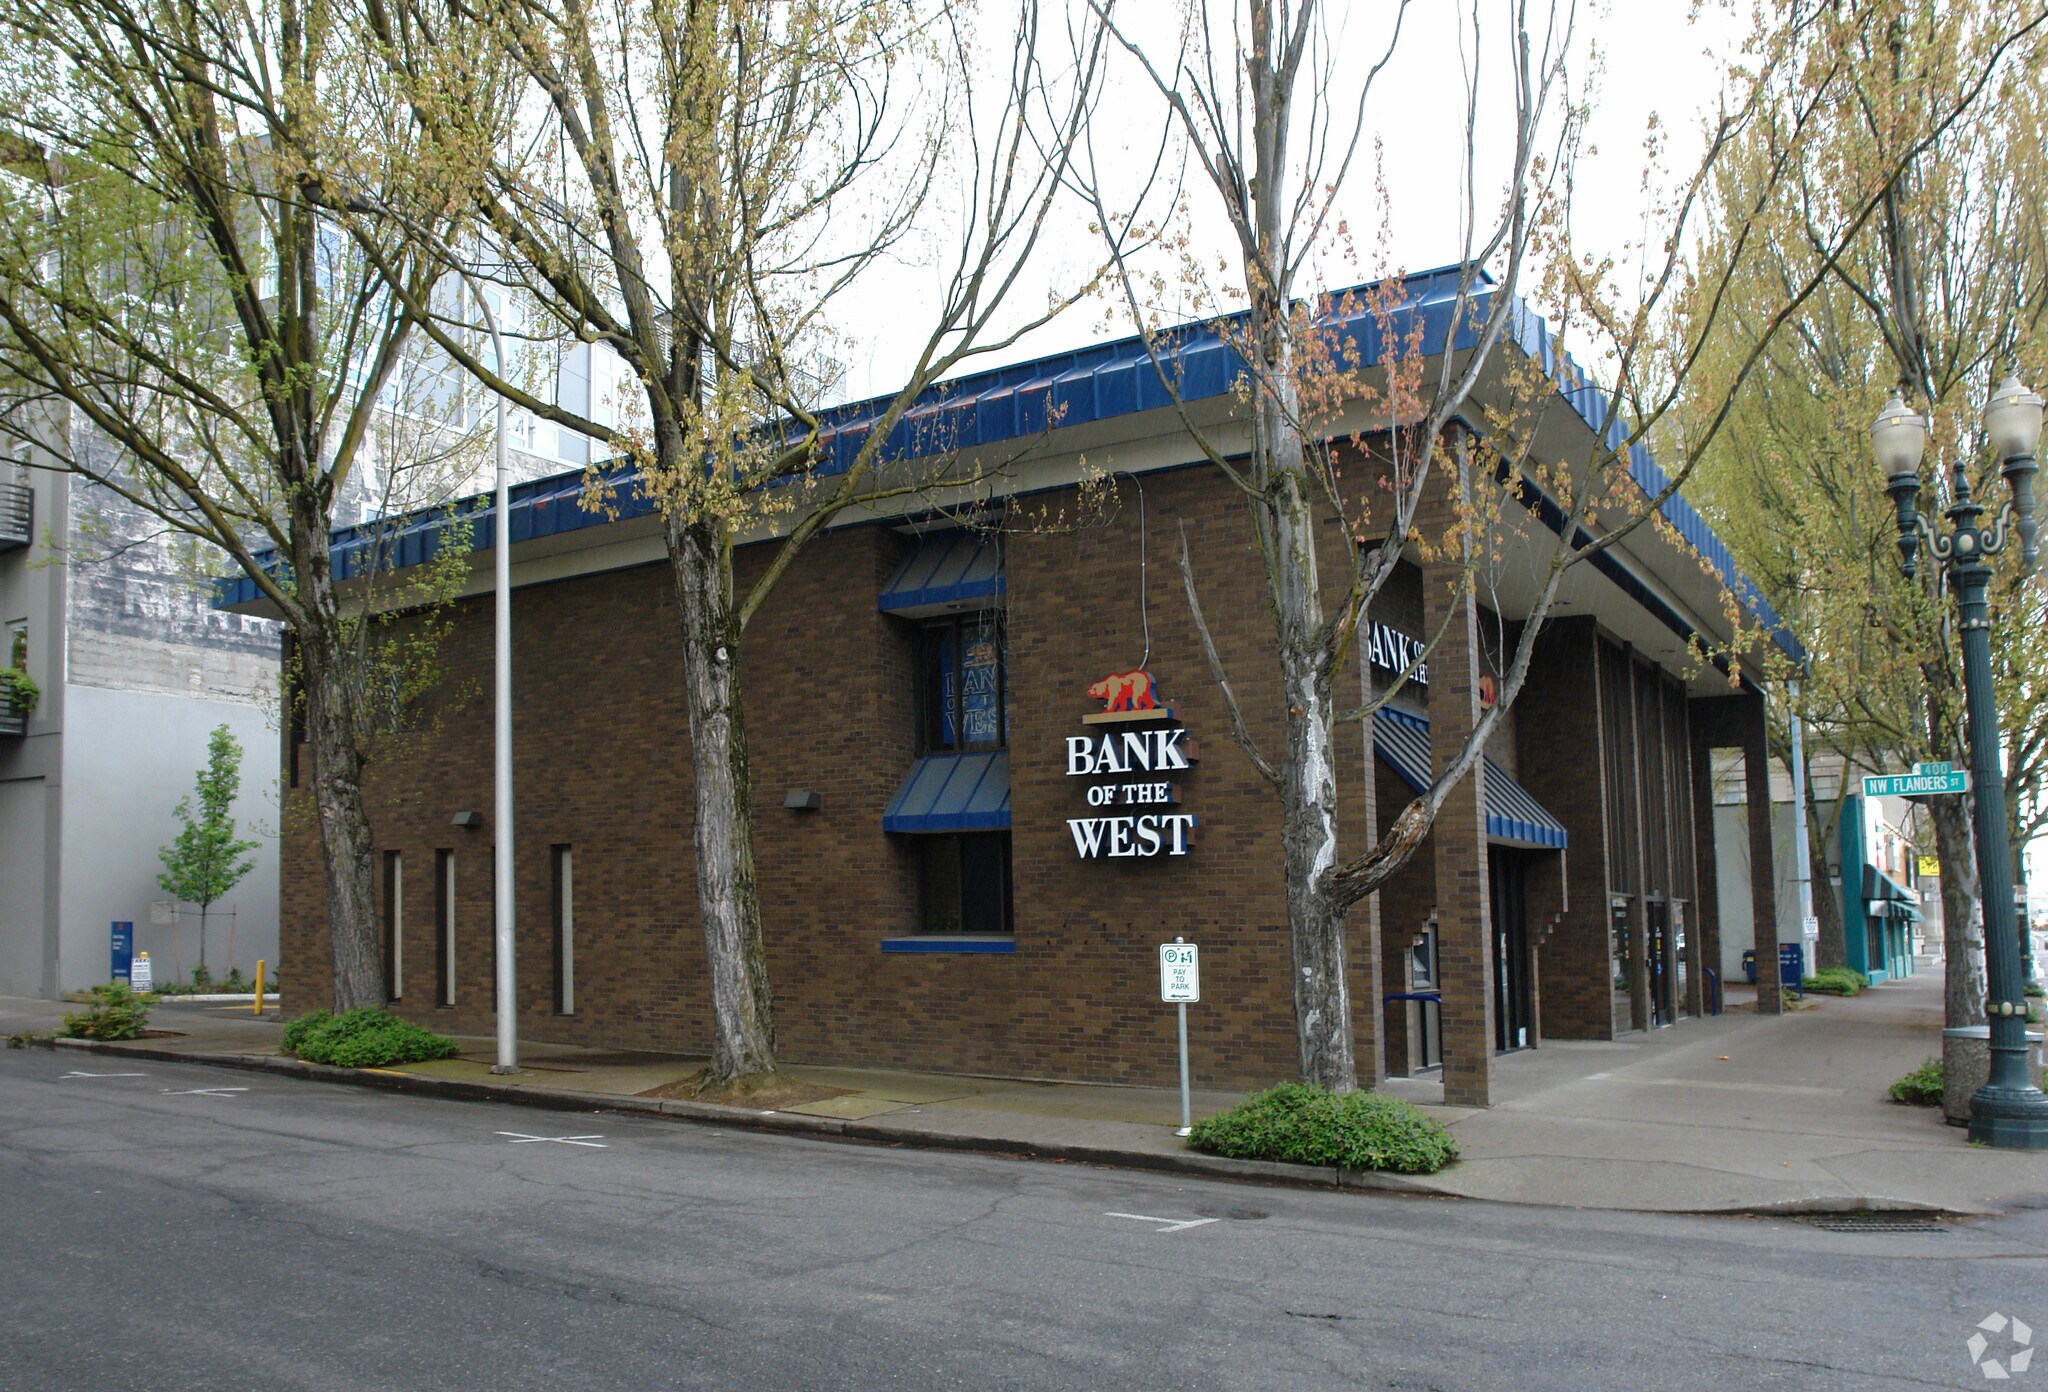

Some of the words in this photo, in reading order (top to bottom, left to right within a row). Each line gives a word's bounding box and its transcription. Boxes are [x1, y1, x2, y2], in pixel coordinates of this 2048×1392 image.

[1065, 729, 1190, 776] BANK
[1924, 764, 1948, 775] 400
[1087, 785, 1117, 807] OF
[1122, 782, 1169, 805] THE
[1869, 778, 1887, 794] NW
[1893, 775, 1948, 793] FLANDERS
[1950, 777, 1959, 787] ST
[1066, 814, 1195, 860] WEST
